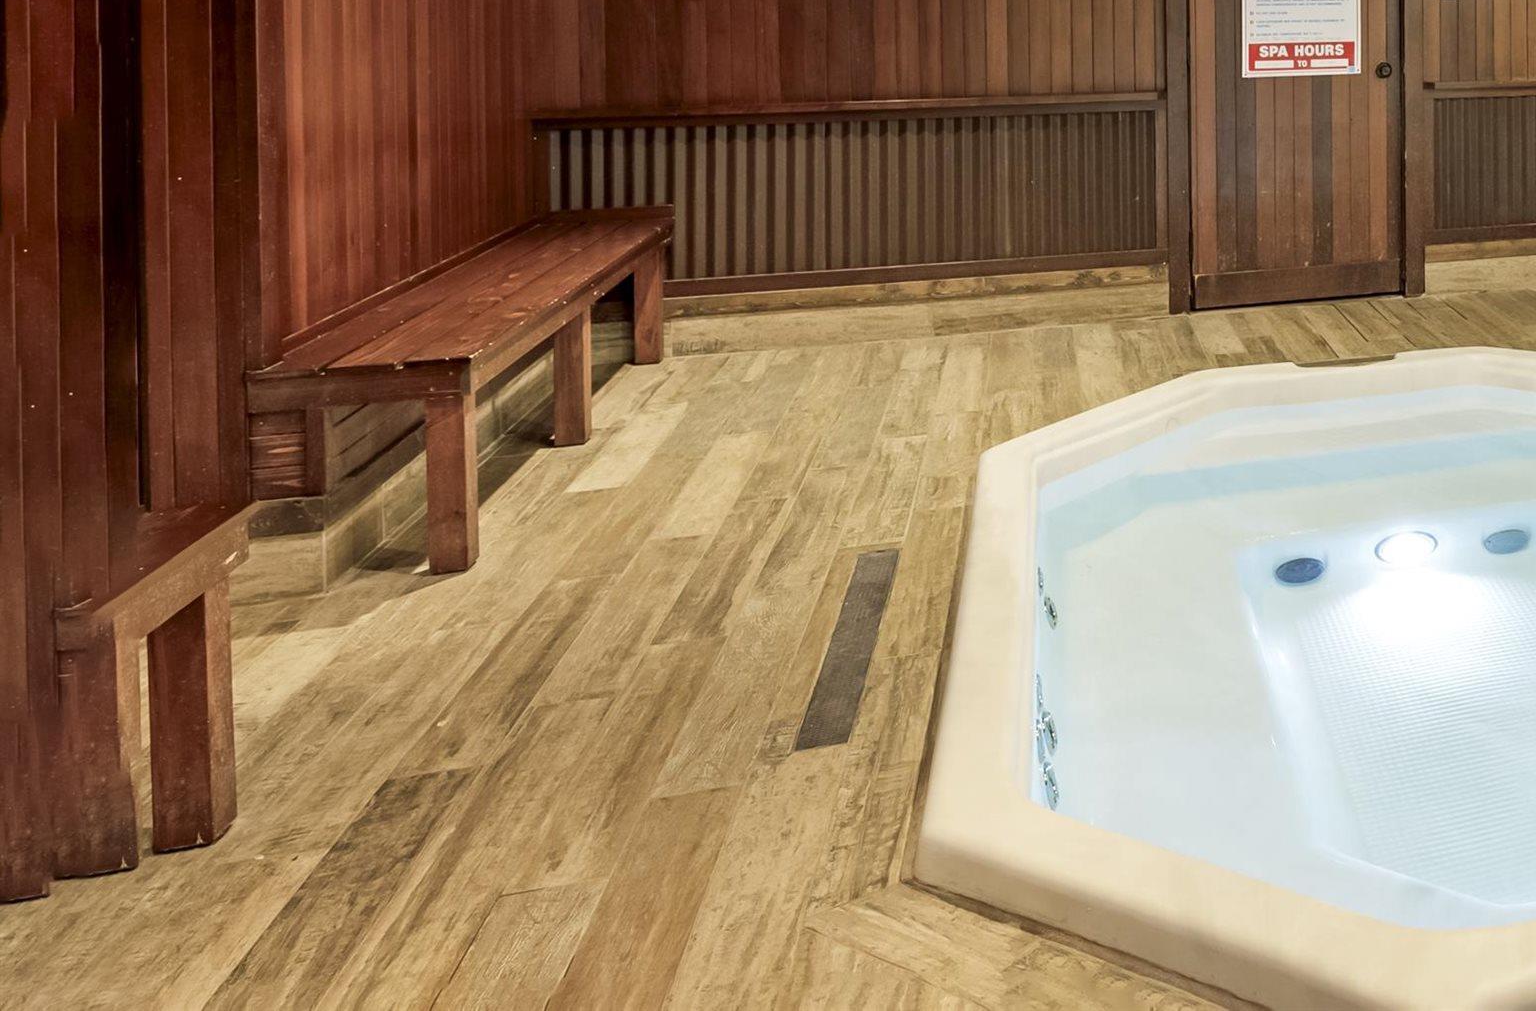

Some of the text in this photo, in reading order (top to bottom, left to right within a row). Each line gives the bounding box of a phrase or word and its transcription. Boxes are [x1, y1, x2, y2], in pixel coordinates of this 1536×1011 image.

[1259, 44, 1345, 58] SPA HOURS
[1296, 60, 1308, 68] TO
